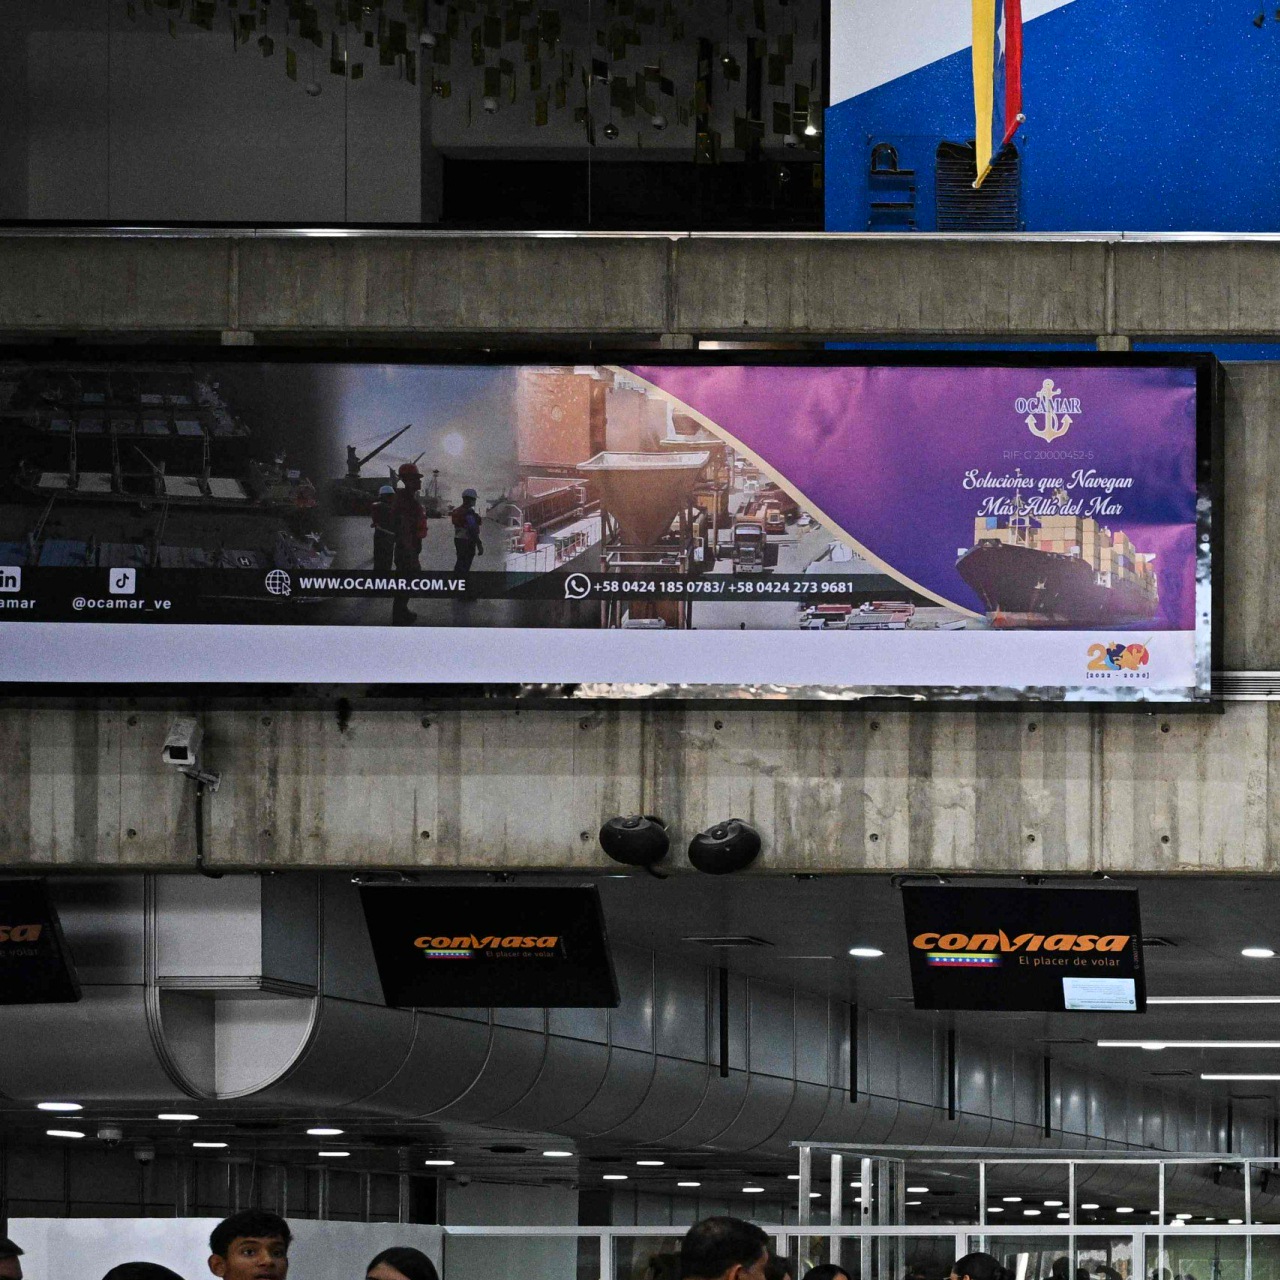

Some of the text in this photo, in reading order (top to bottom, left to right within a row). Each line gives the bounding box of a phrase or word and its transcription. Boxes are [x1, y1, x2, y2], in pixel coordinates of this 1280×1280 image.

[1015, 397, 1082, 414] OCAMAR
[963, 468, 1134, 494] Soluciones que Navegan
[977, 496, 1124, 517] Más Allá del Mar
[299, 577, 466, 591] WWW.OCAMAR.COM.VE
[594, 581, 854, 594] +58 0424 185 0783/ +58 0424 273 9681
[72, 597, 172, 611] @ocamar_ve
[413, 933, 559, 949] conviasa
[912, 929, 1130, 952] conviasa
[1019, 956, 1121, 968] El placer de volar
